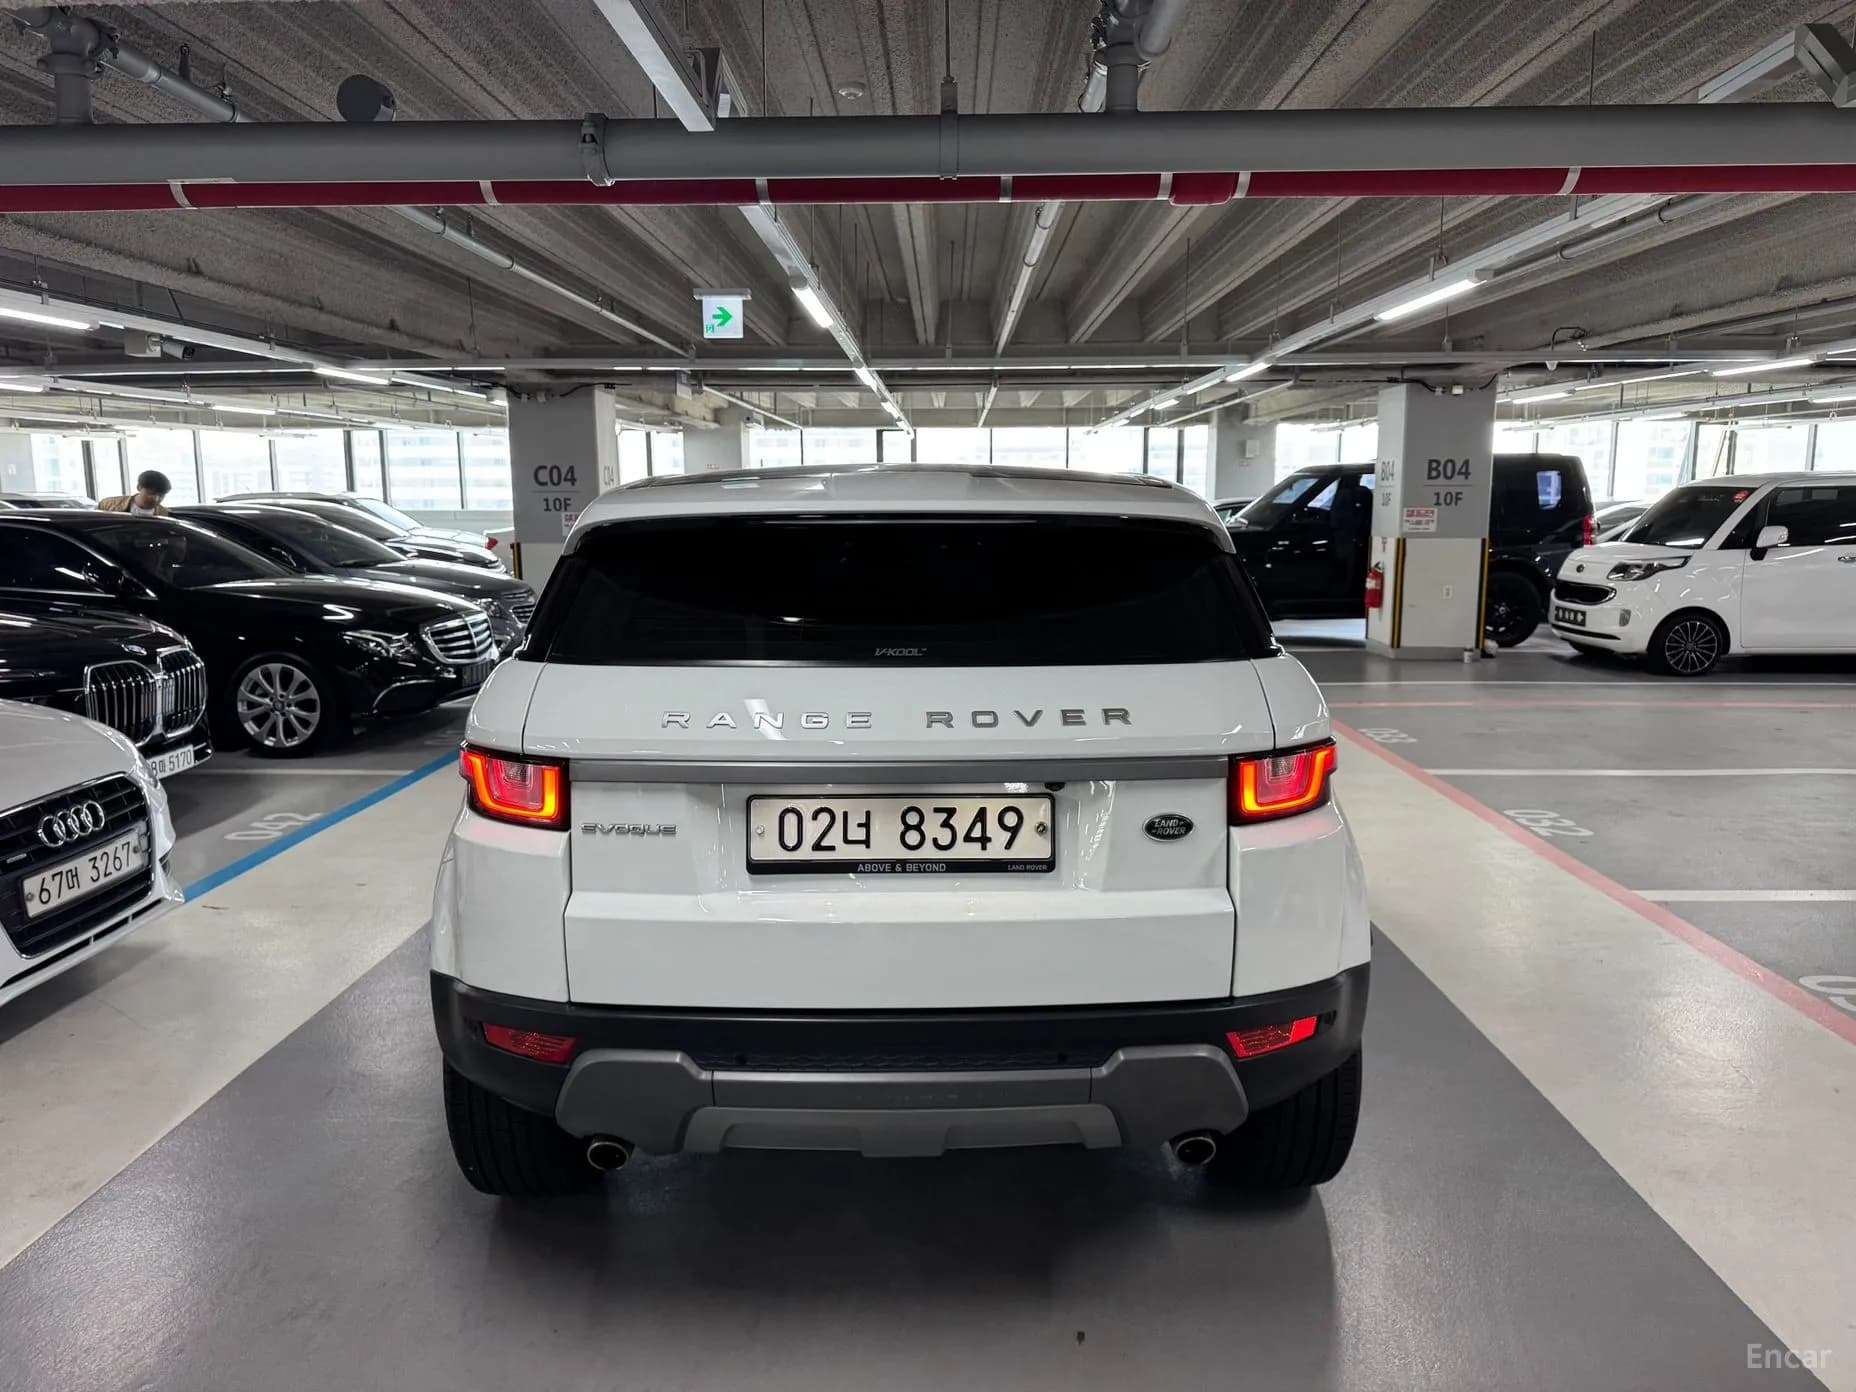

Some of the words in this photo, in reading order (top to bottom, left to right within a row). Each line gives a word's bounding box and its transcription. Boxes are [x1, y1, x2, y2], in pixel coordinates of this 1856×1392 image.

[533, 465, 577, 487] C04
[603, 465, 615, 487] C04
[1426, 458, 1472, 481] B04
[543, 497, 572, 512] 10F
[1433, 491, 1464, 507] 10F
[661, 711, 873, 729] RANGE
[925, 707, 1132, 729] ROVER
[169, 749, 192, 772] 5170
[581, 822, 677, 837] EVOQUE
[778, 806, 871, 851] 02너
[899, 805, 1024, 851] 8349
[38, 866, 80, 904] 67머
[88, 841, 131, 883] 3267
[857, 863, 892, 873] ABOVE
[895, 863, 903, 873] &
[906, 863, 947, 873] BEYOND
